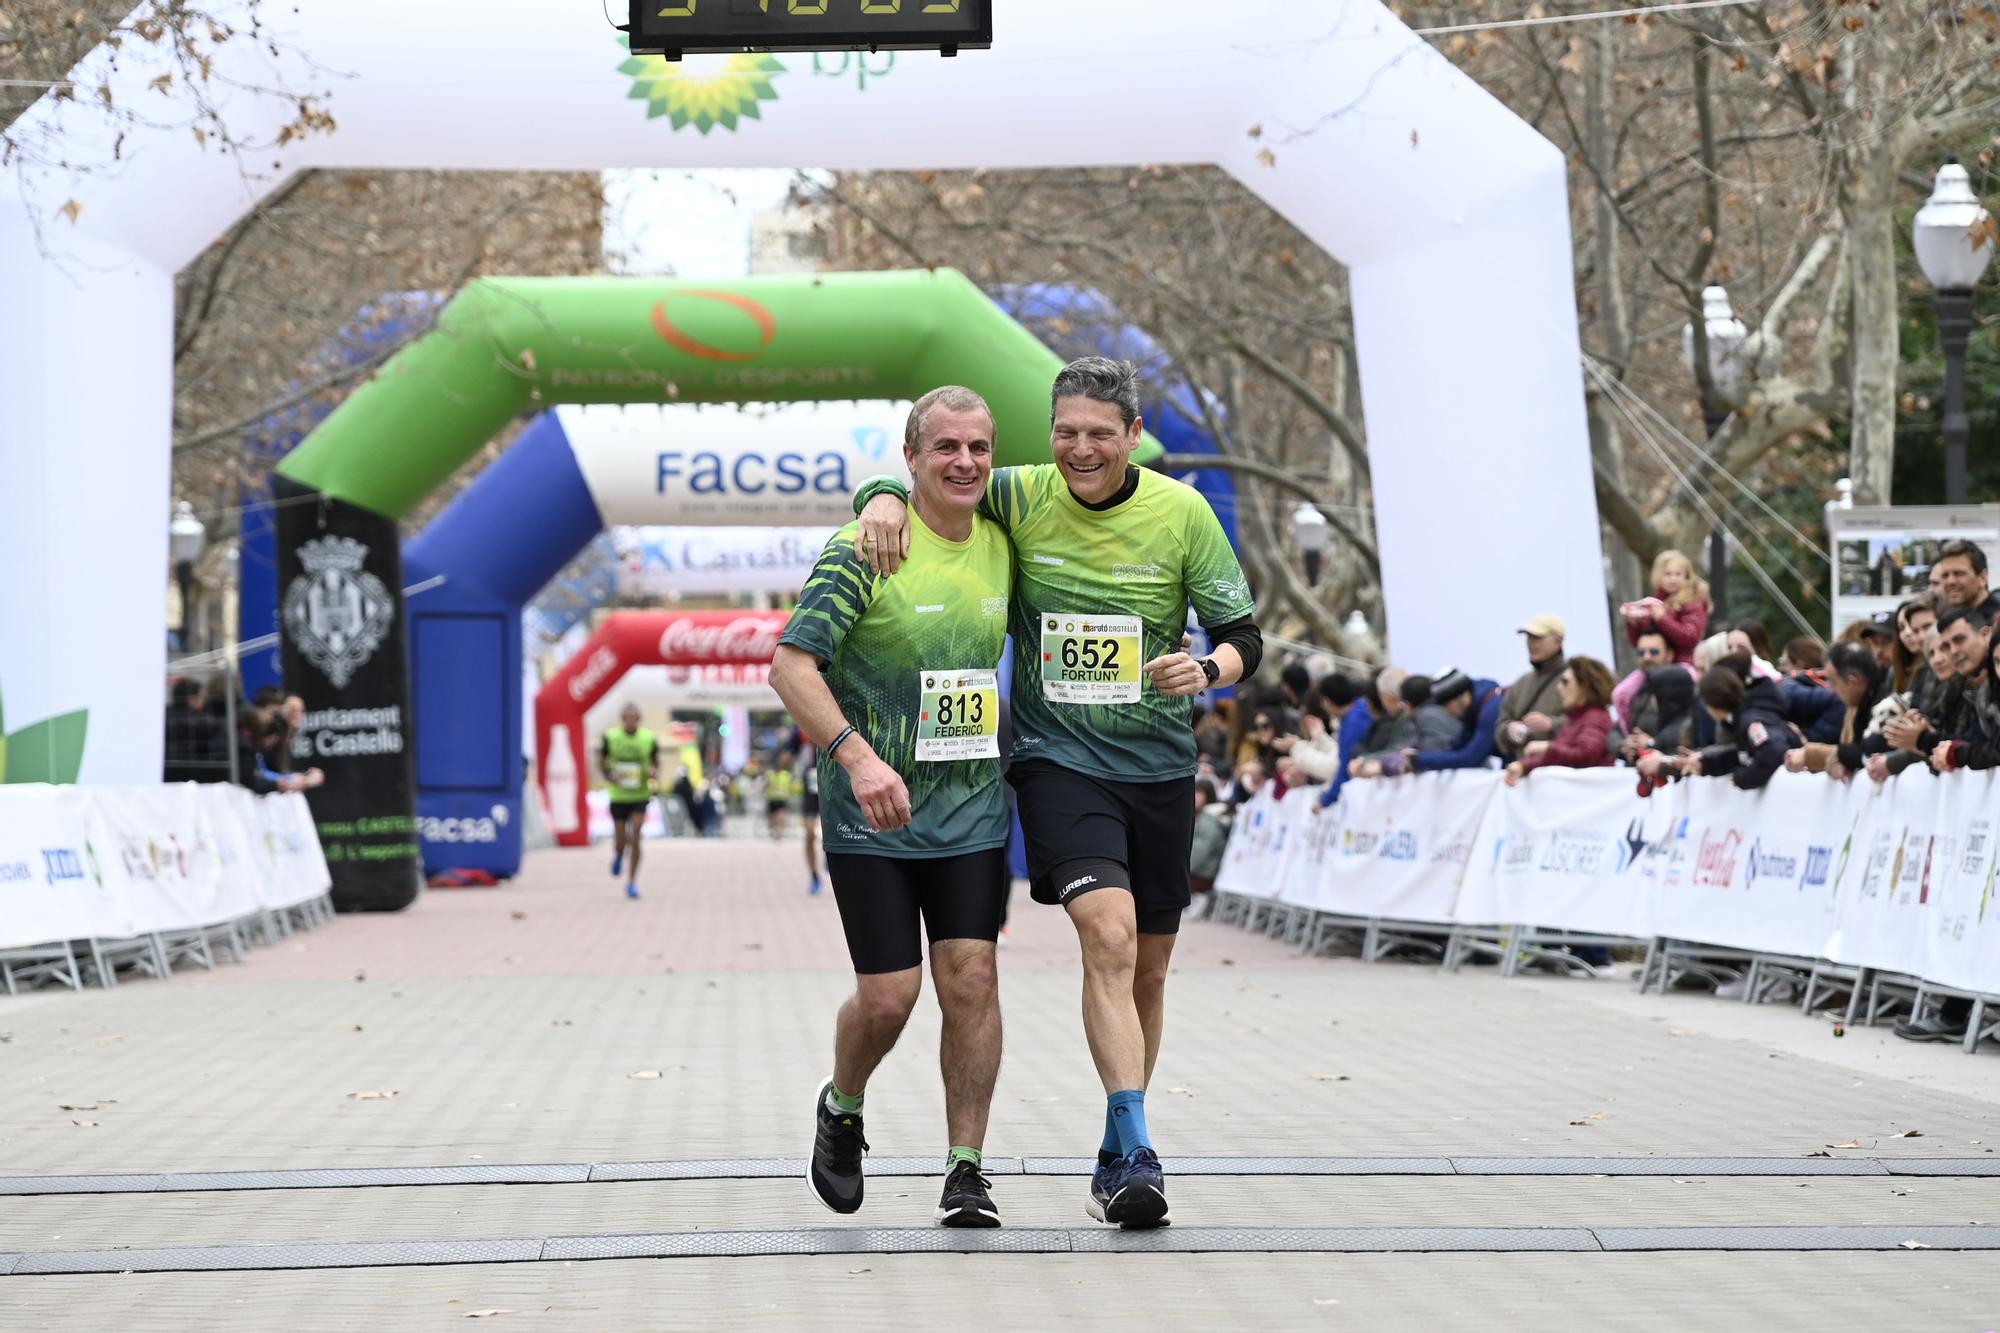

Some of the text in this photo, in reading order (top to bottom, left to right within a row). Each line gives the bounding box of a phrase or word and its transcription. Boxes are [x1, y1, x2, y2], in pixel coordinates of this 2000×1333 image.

[1061, 637, 1120, 669] 652
[1061, 669, 1120, 681] FORTUNY
[937, 692, 983, 726] 813
[934, 724, 983, 738] FEDERICO
[1059, 875, 1097, 899] LURBEL
